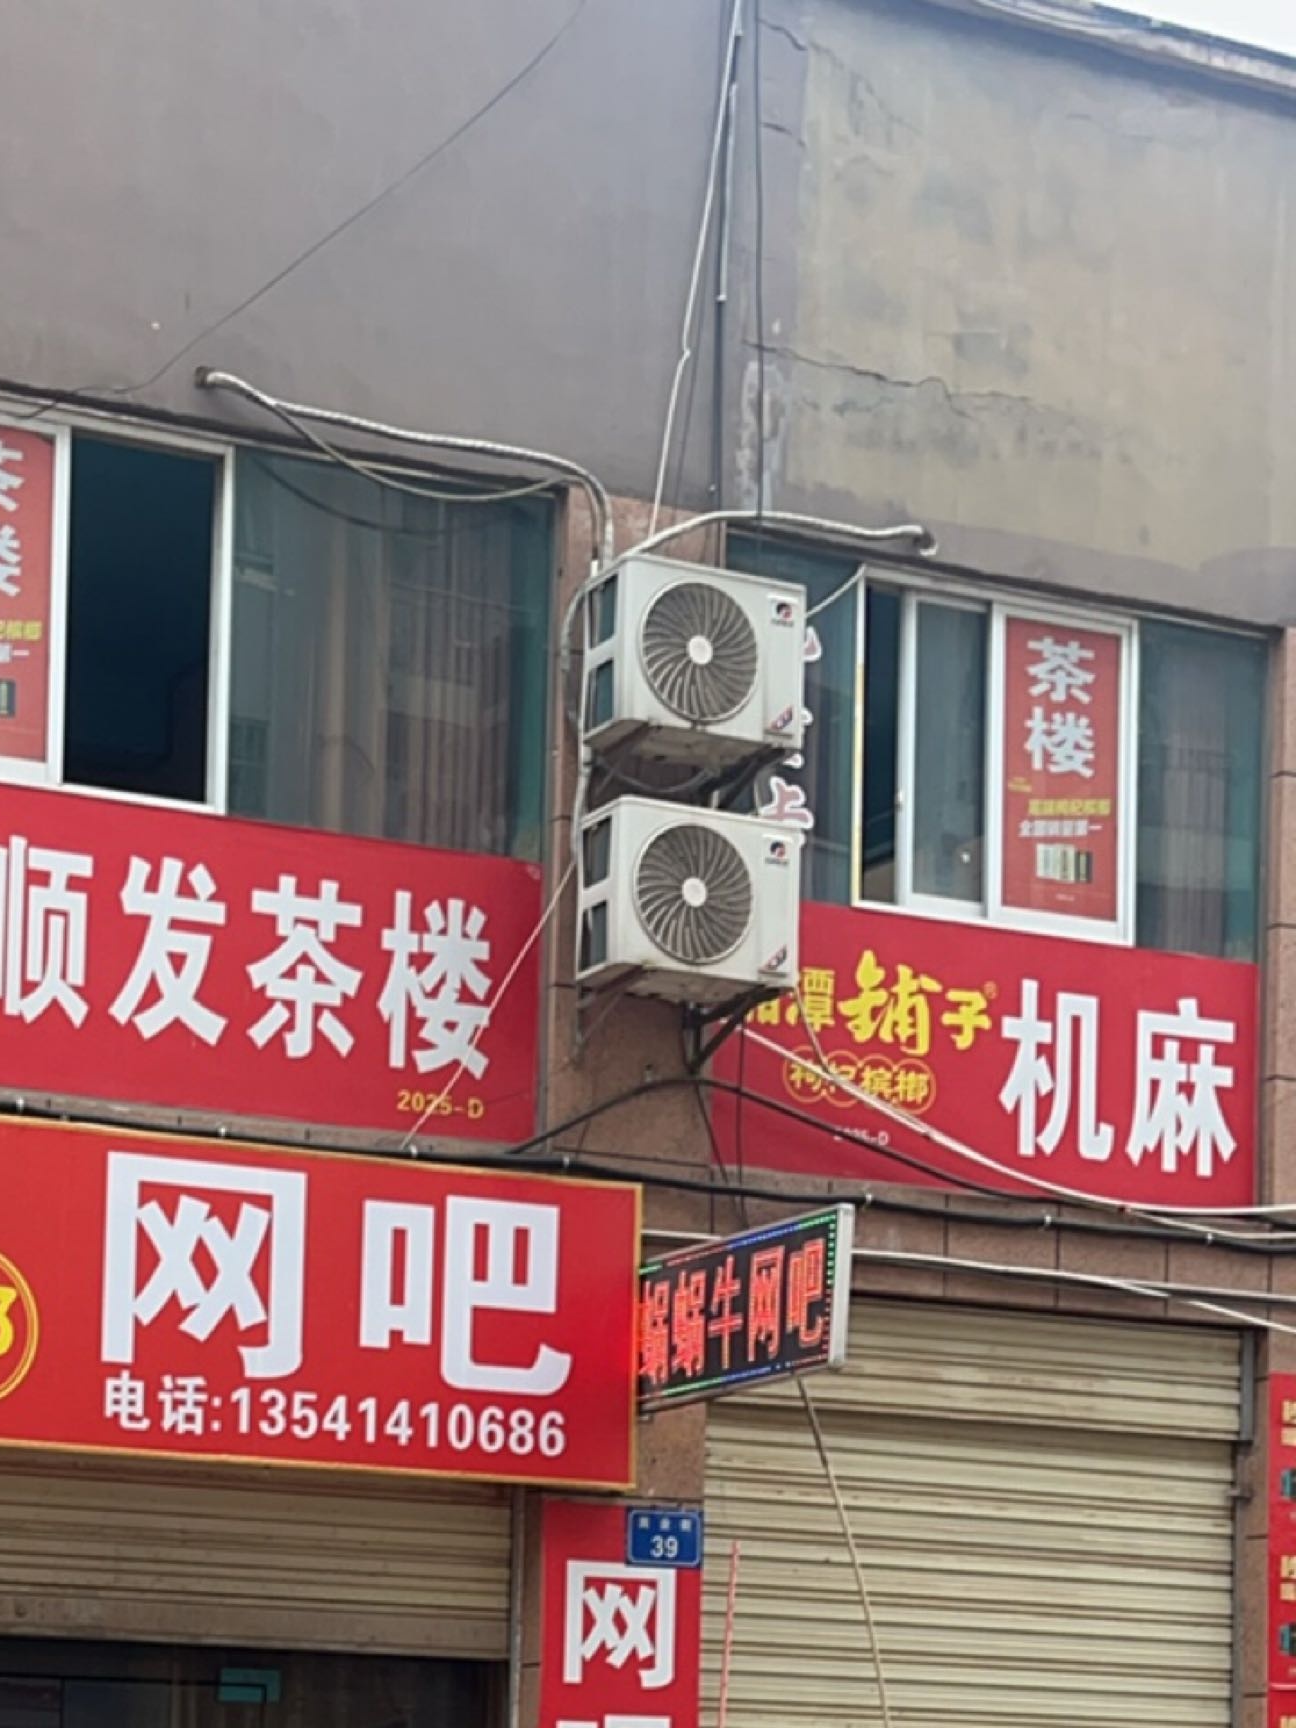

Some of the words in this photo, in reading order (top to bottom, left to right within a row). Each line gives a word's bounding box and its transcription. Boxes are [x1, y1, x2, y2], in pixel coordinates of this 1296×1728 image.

[1023, 635, 1095, 779] 茶楼
[1000, 978, 1237, 1178] 机麻
[101, 1150, 572, 1396] 网吧
[104, 1370, 567, 1459] 电话:13541410686
[650, 1534, 678, 1558] 39
